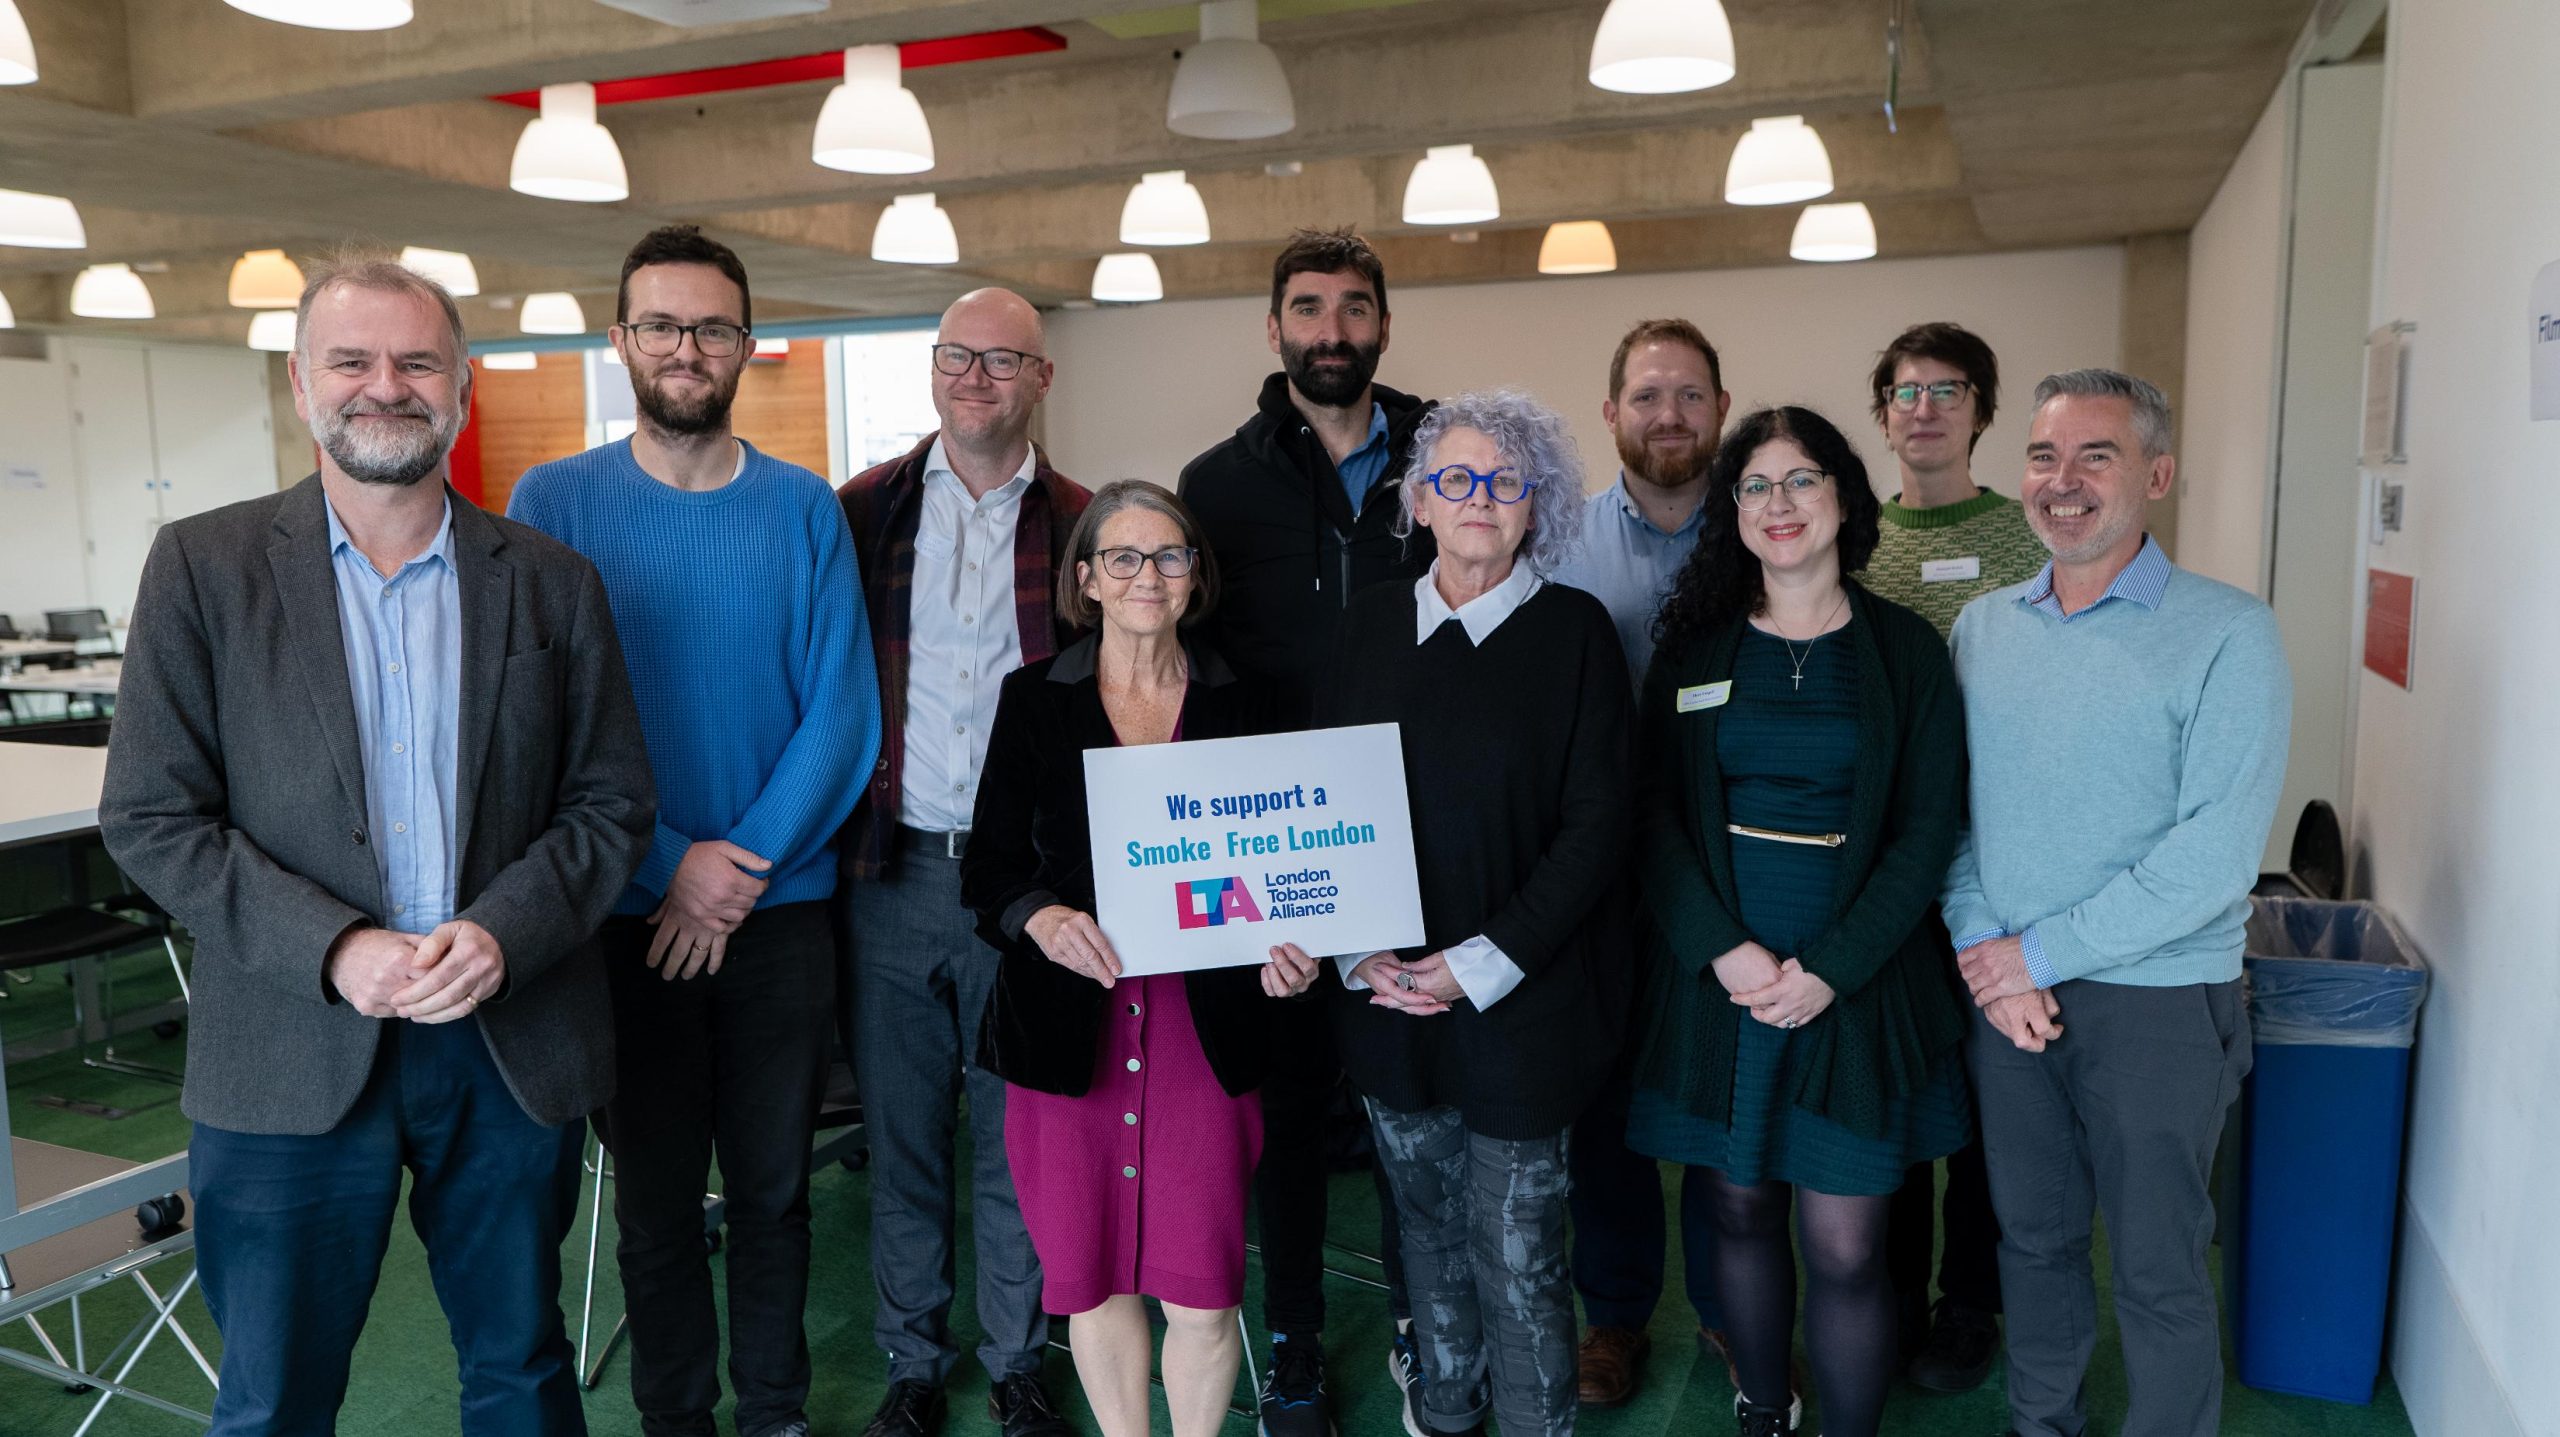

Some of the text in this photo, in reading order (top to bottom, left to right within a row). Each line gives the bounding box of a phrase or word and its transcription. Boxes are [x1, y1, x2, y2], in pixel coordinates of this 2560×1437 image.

[1166, 784, 1327, 820] We support a
[1126, 820, 1376, 868] Smoke Free London
[1265, 868, 1331, 887] London
[1175, 876, 1264, 930] LTA
[1267, 885, 1339, 904] Tobacco
[1269, 901, 1336, 921] Alliance
